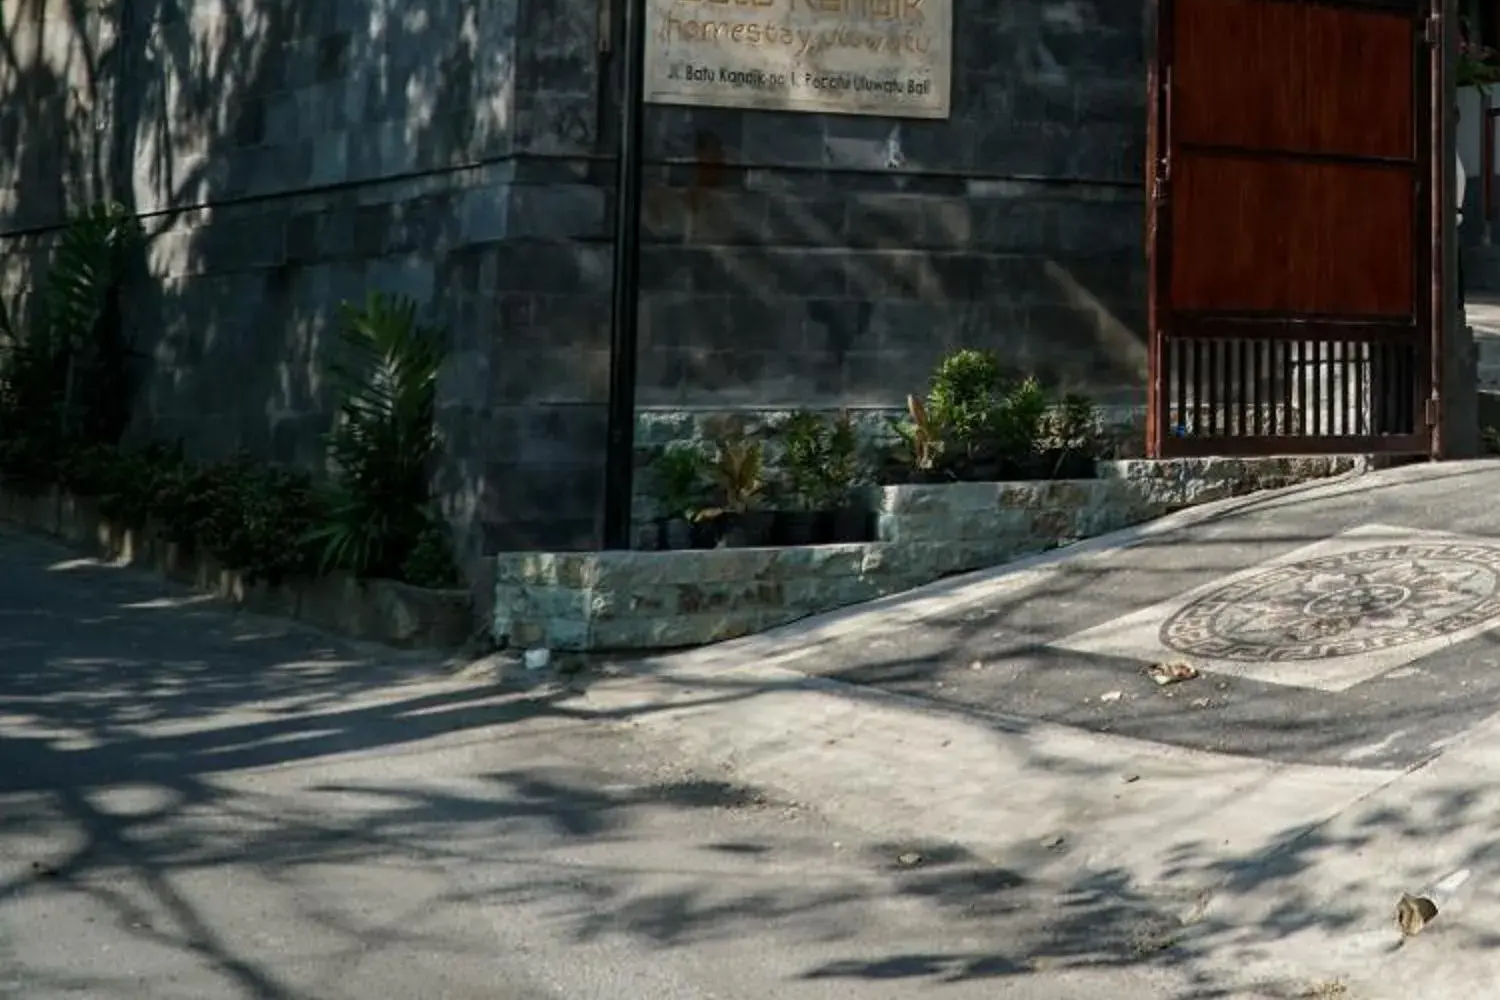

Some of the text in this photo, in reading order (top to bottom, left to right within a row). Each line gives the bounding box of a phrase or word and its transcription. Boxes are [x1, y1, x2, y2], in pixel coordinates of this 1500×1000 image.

[667, 11, 810, 57] homestay
[686, 64, 715, 83] Batu
[907, 78, 930, 96] Bali
